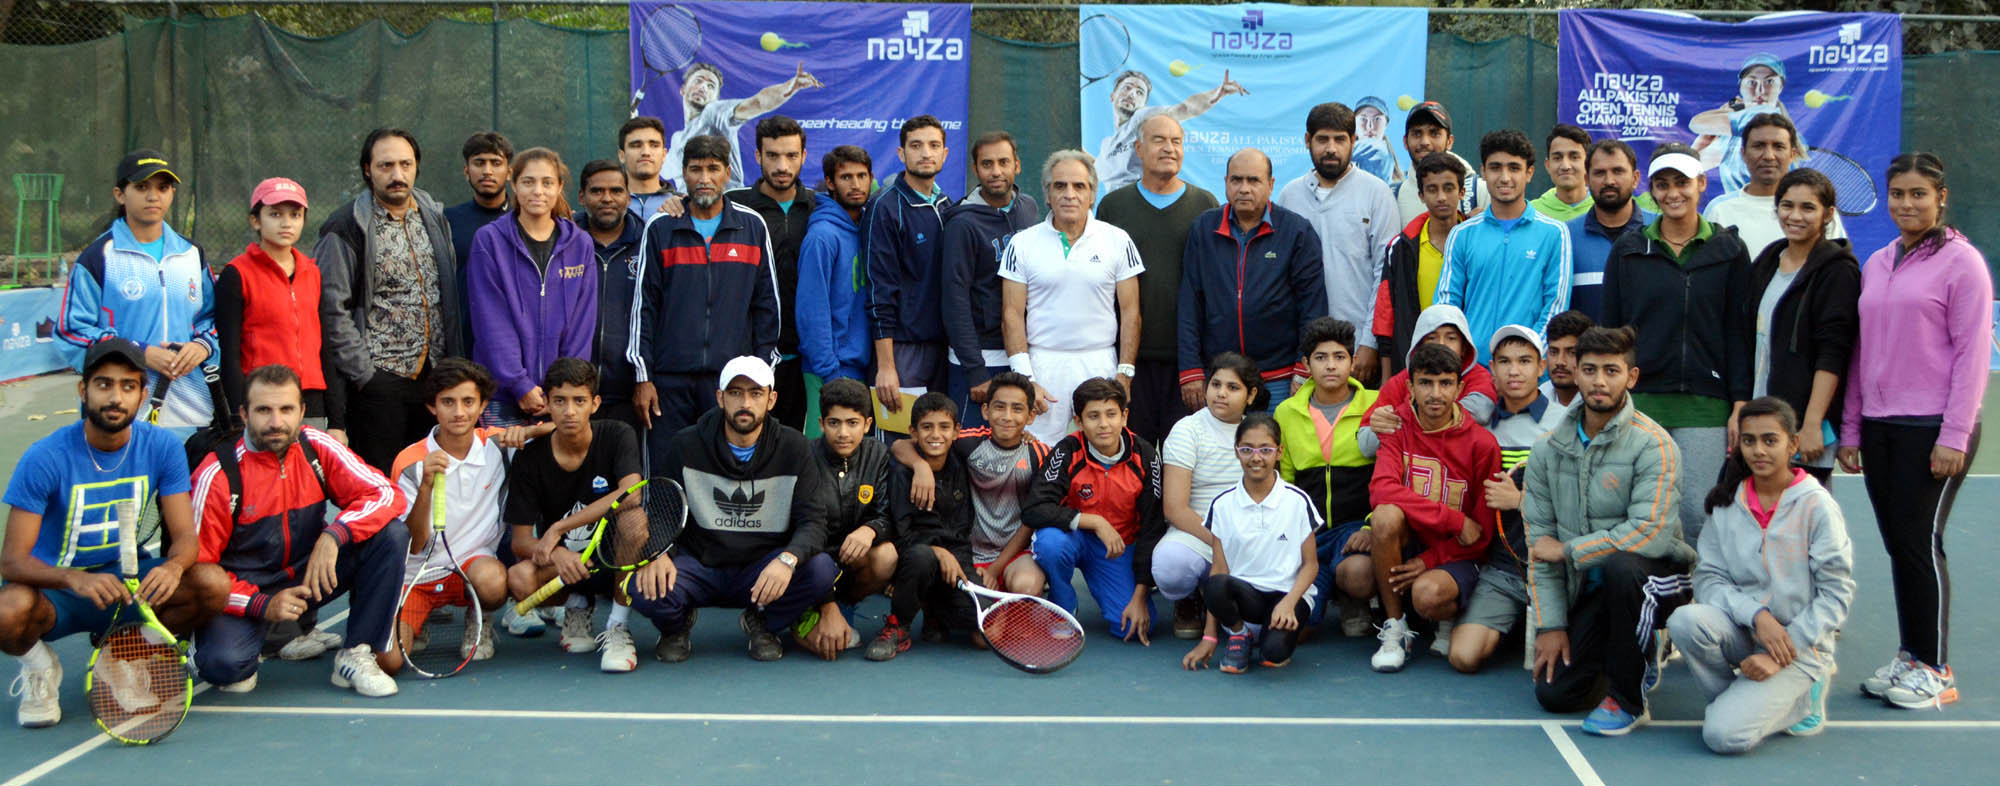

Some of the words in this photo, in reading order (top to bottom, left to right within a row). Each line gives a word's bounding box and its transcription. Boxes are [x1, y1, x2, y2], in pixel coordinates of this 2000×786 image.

[867, 37, 963, 60] nayza
[1211, 31, 1293, 50] nayza
[1808, 43, 1889, 65] nayza
[1594, 71, 1664, 92] nayza
[1575, 108, 1679, 121] CHAMPIONSHIP
[1579, 101, 1621, 115] OPEN
[1622, 102, 1676, 117] TENNIS
[797, 117, 889, 133] pearheading
[891, 118, 905, 129] th
[940, 120, 962, 130] me
[1622, 119, 1649, 129] 2017
[1256, 135, 1305, 145] PAKISTA
[975, 458, 1007, 473] EAM
[714, 517, 762, 528] adidas
